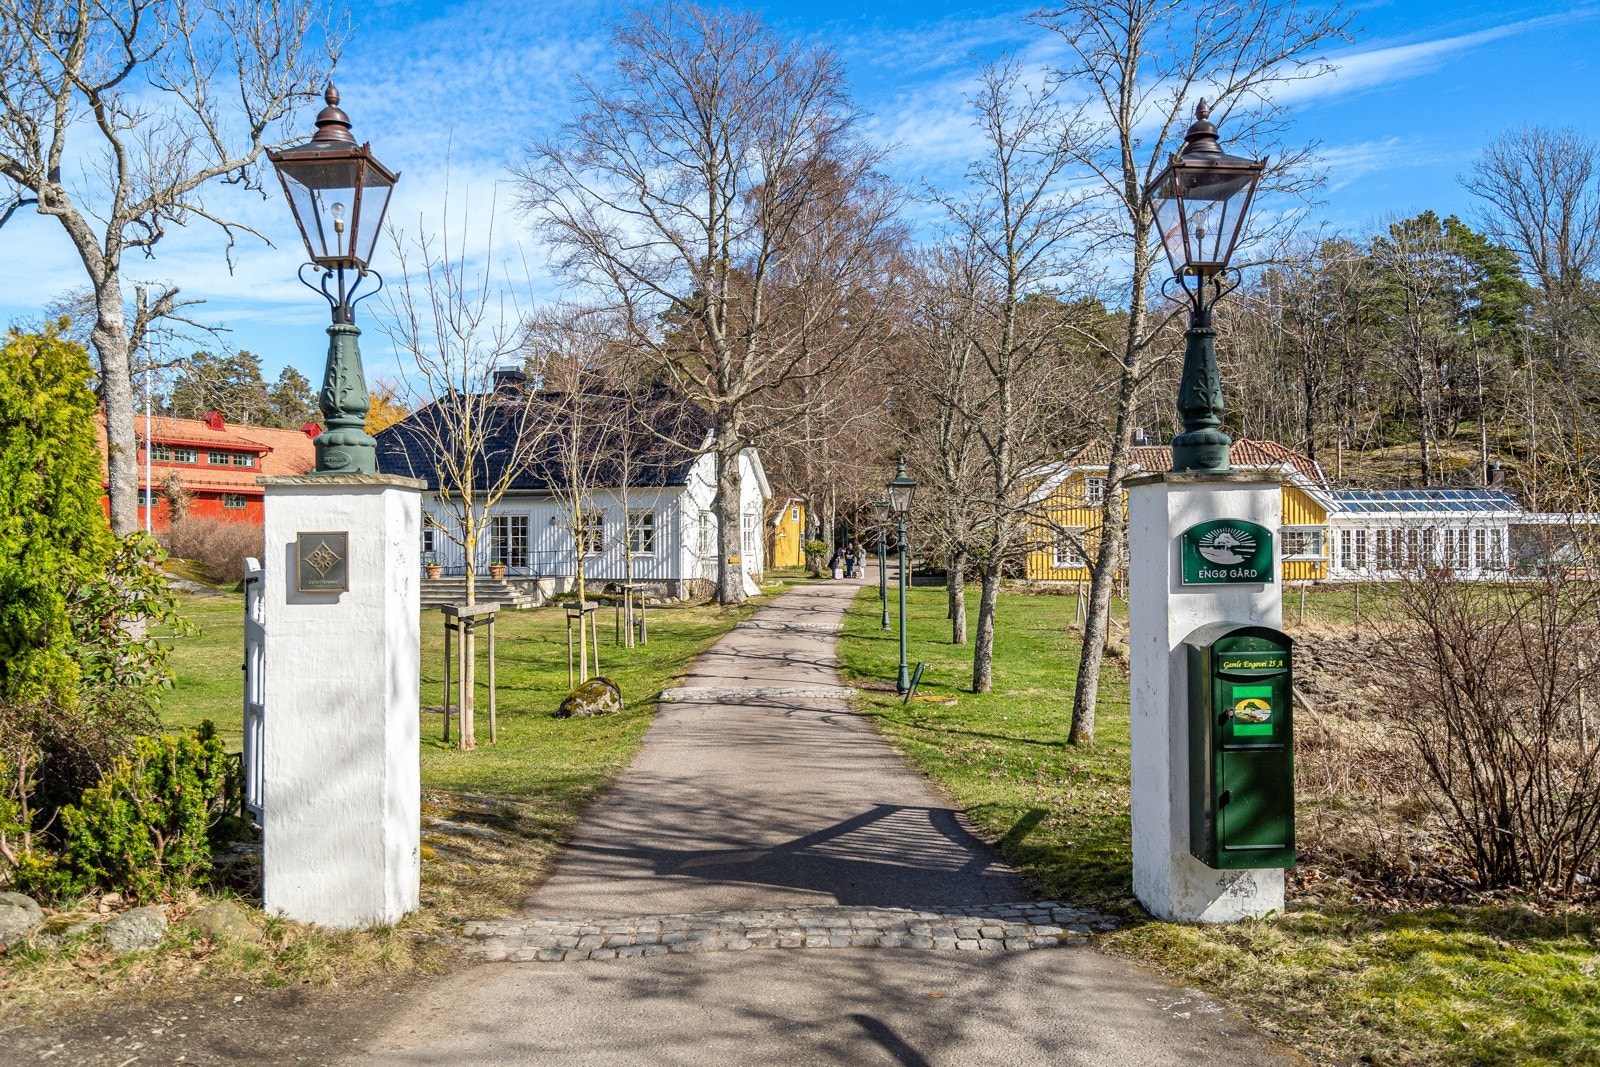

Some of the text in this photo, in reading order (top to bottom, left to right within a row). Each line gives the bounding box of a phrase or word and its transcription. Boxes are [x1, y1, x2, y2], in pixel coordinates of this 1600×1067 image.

[1198, 567, 1258, 578] ENGØ GÅRD
[1223, 660, 1242, 670] Gamle
